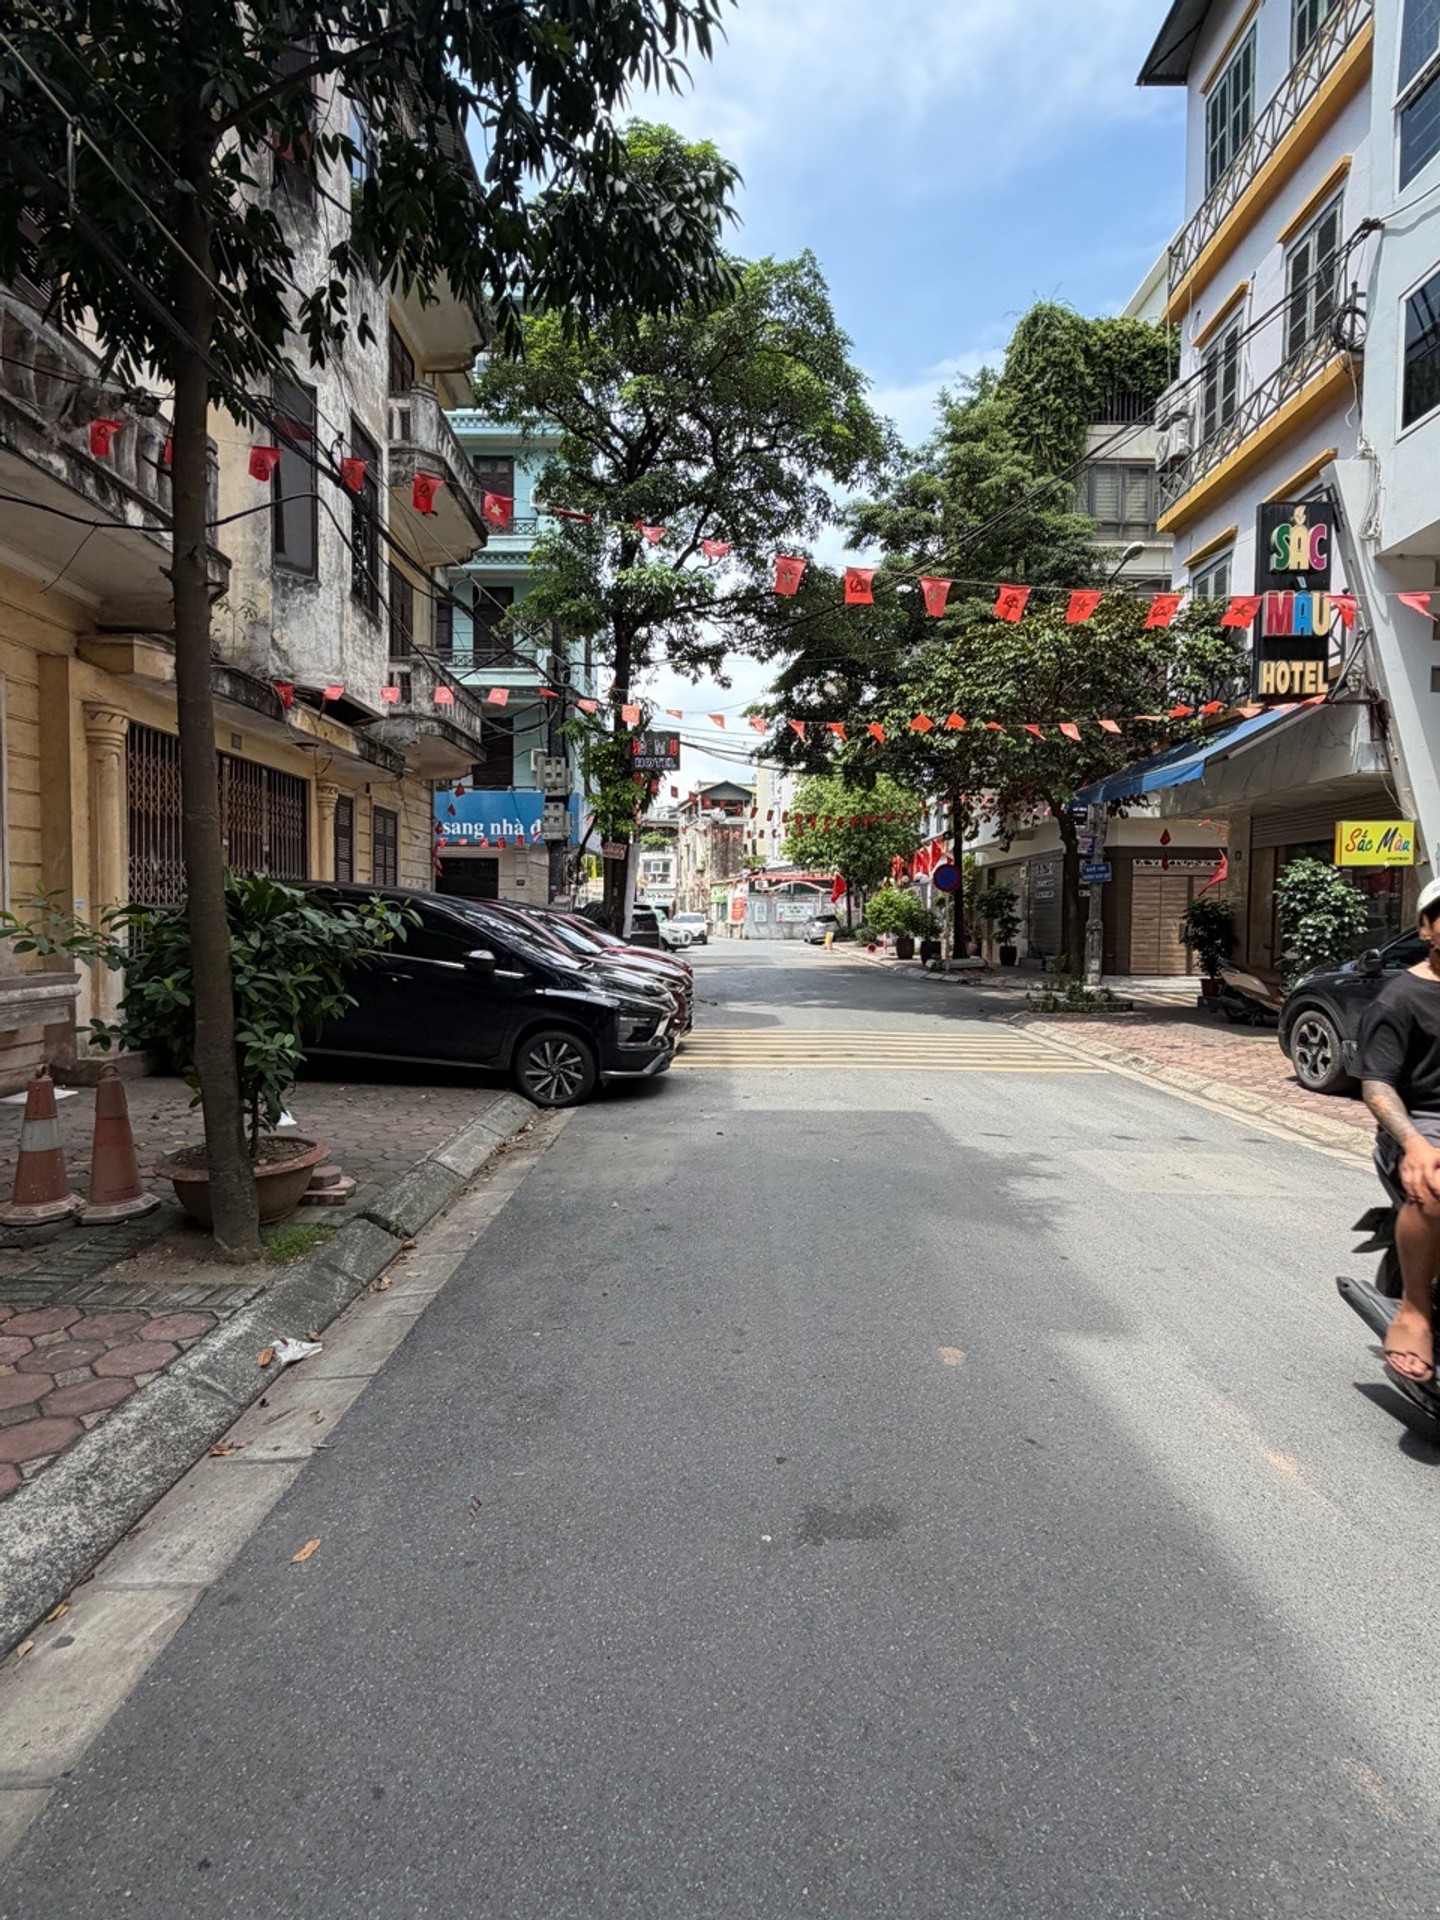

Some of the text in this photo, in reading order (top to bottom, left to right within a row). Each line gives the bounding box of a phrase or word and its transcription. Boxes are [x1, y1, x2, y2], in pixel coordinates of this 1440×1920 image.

[1270, 505, 1328, 572] SẮC
[1263, 576, 1331, 637] MÀU
[1258, 660, 1329, 695] HOTEL
[442, 821, 485, 840] sang
[490, 818, 524, 836] nhà
[1344, 827, 1374, 852] Sắc
